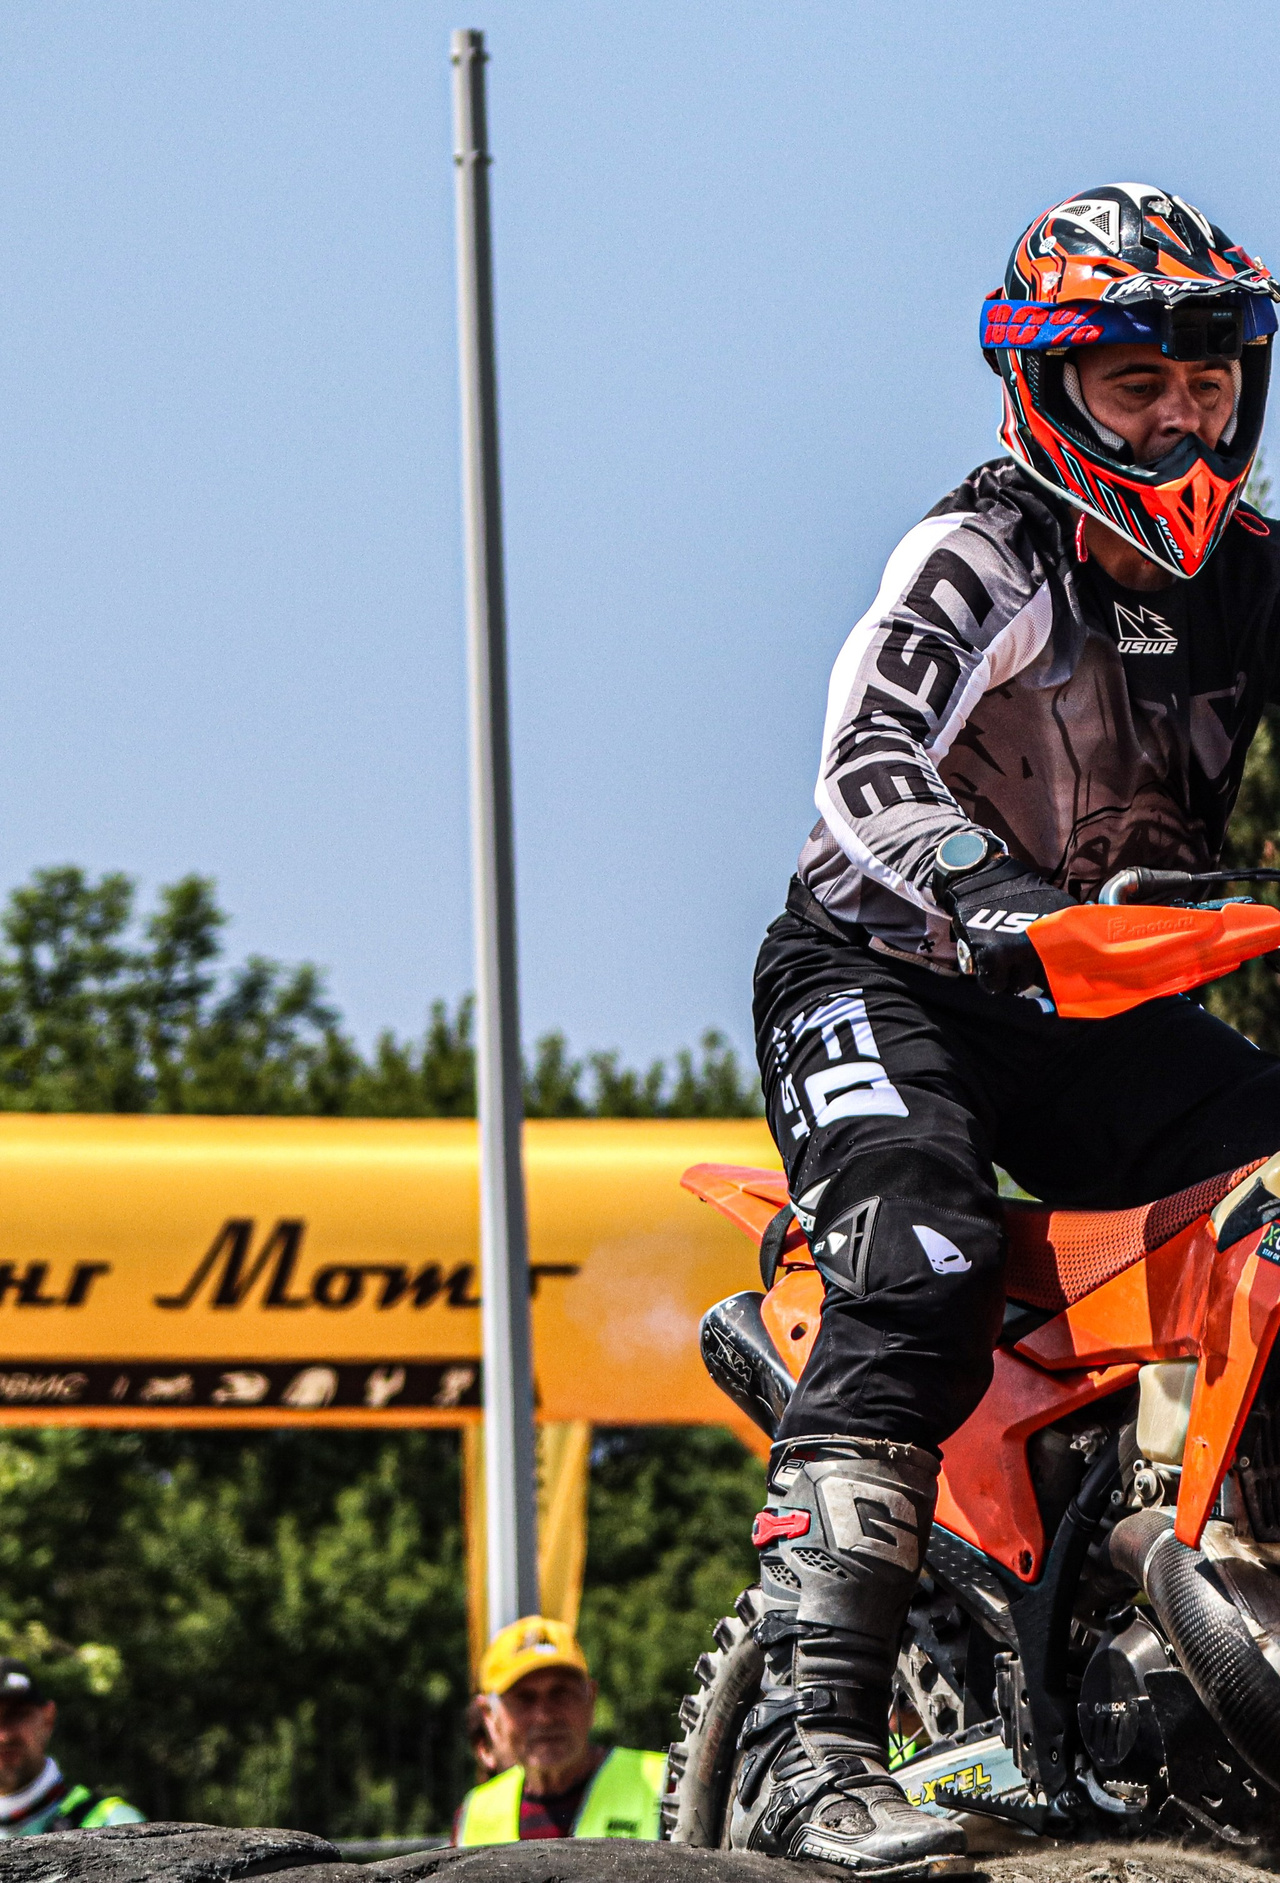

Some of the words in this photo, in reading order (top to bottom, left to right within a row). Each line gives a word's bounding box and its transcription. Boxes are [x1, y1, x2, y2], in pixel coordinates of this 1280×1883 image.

[1117, 641, 1178, 654] USWE
[966, 908, 1049, 934] US
[1262, 1248, 1274, 1257] STAY
[1272, 1252, 1280, 1260] ON
